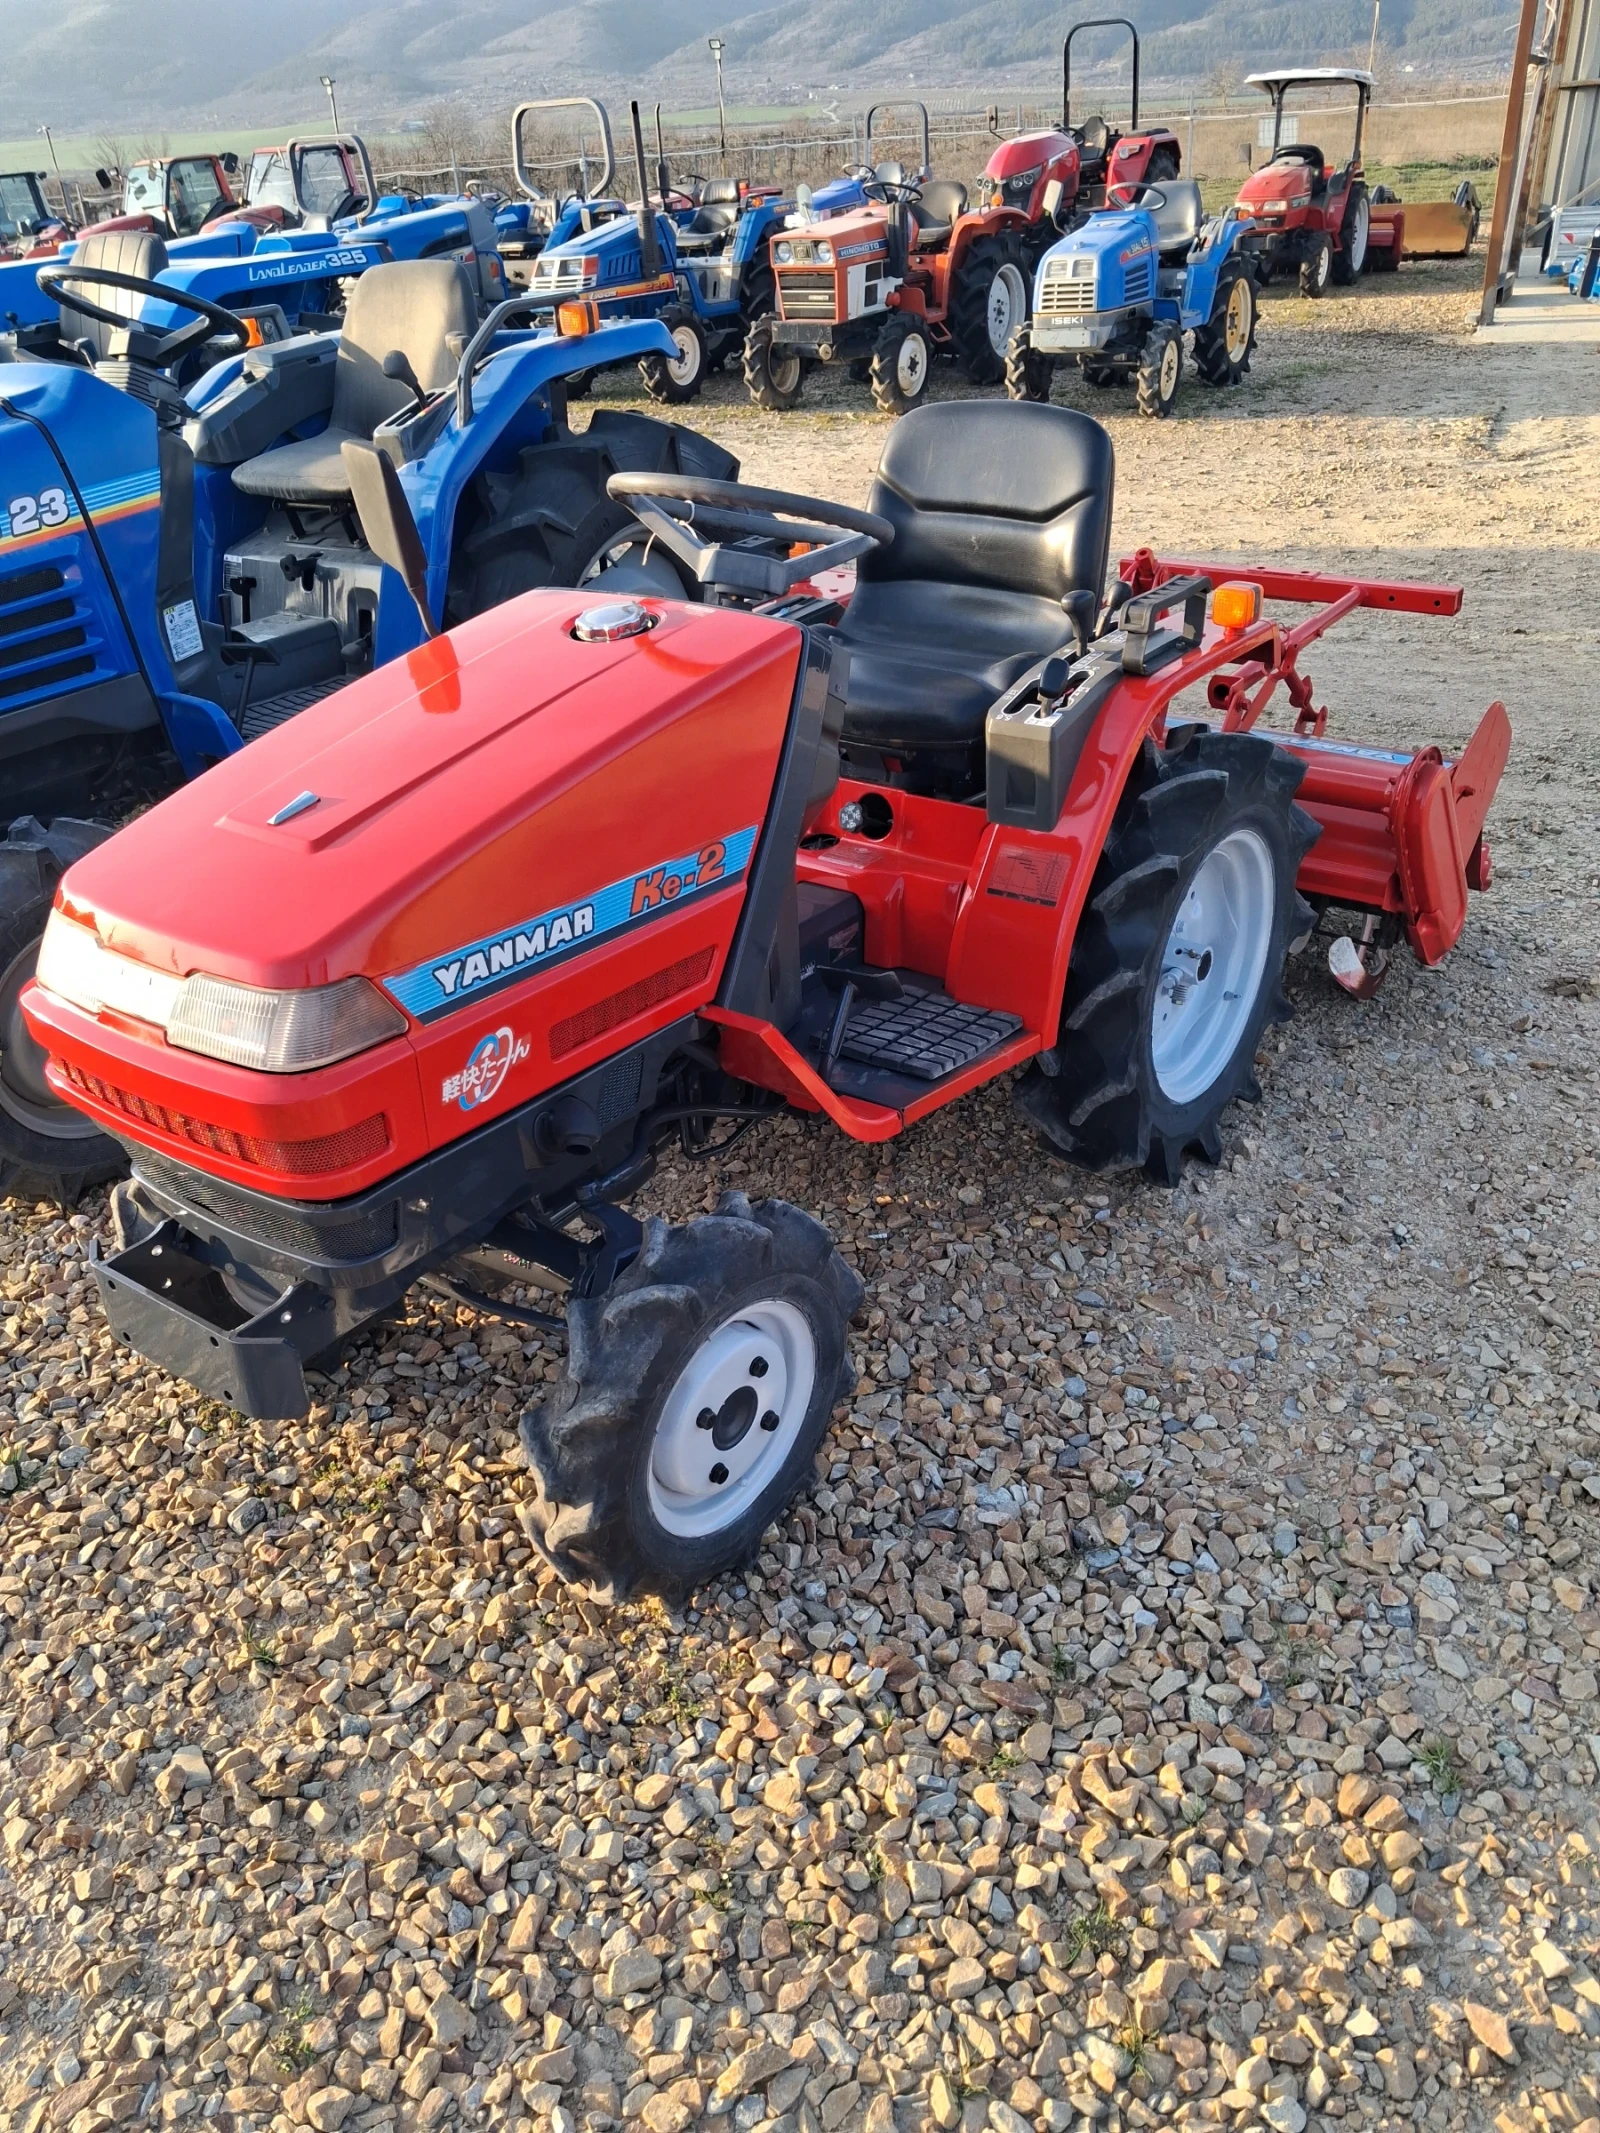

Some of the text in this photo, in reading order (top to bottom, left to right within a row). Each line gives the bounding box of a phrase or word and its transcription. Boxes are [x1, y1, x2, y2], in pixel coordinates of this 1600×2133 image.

[327, 249, 368, 267] 325
[840, 242, 880, 257] HINOMOTO
[1051, 315, 1084, 325] ISEKI
[9, 487, 70, 537] 23
[432, 841, 727, 996] YANMAR Ke-2
